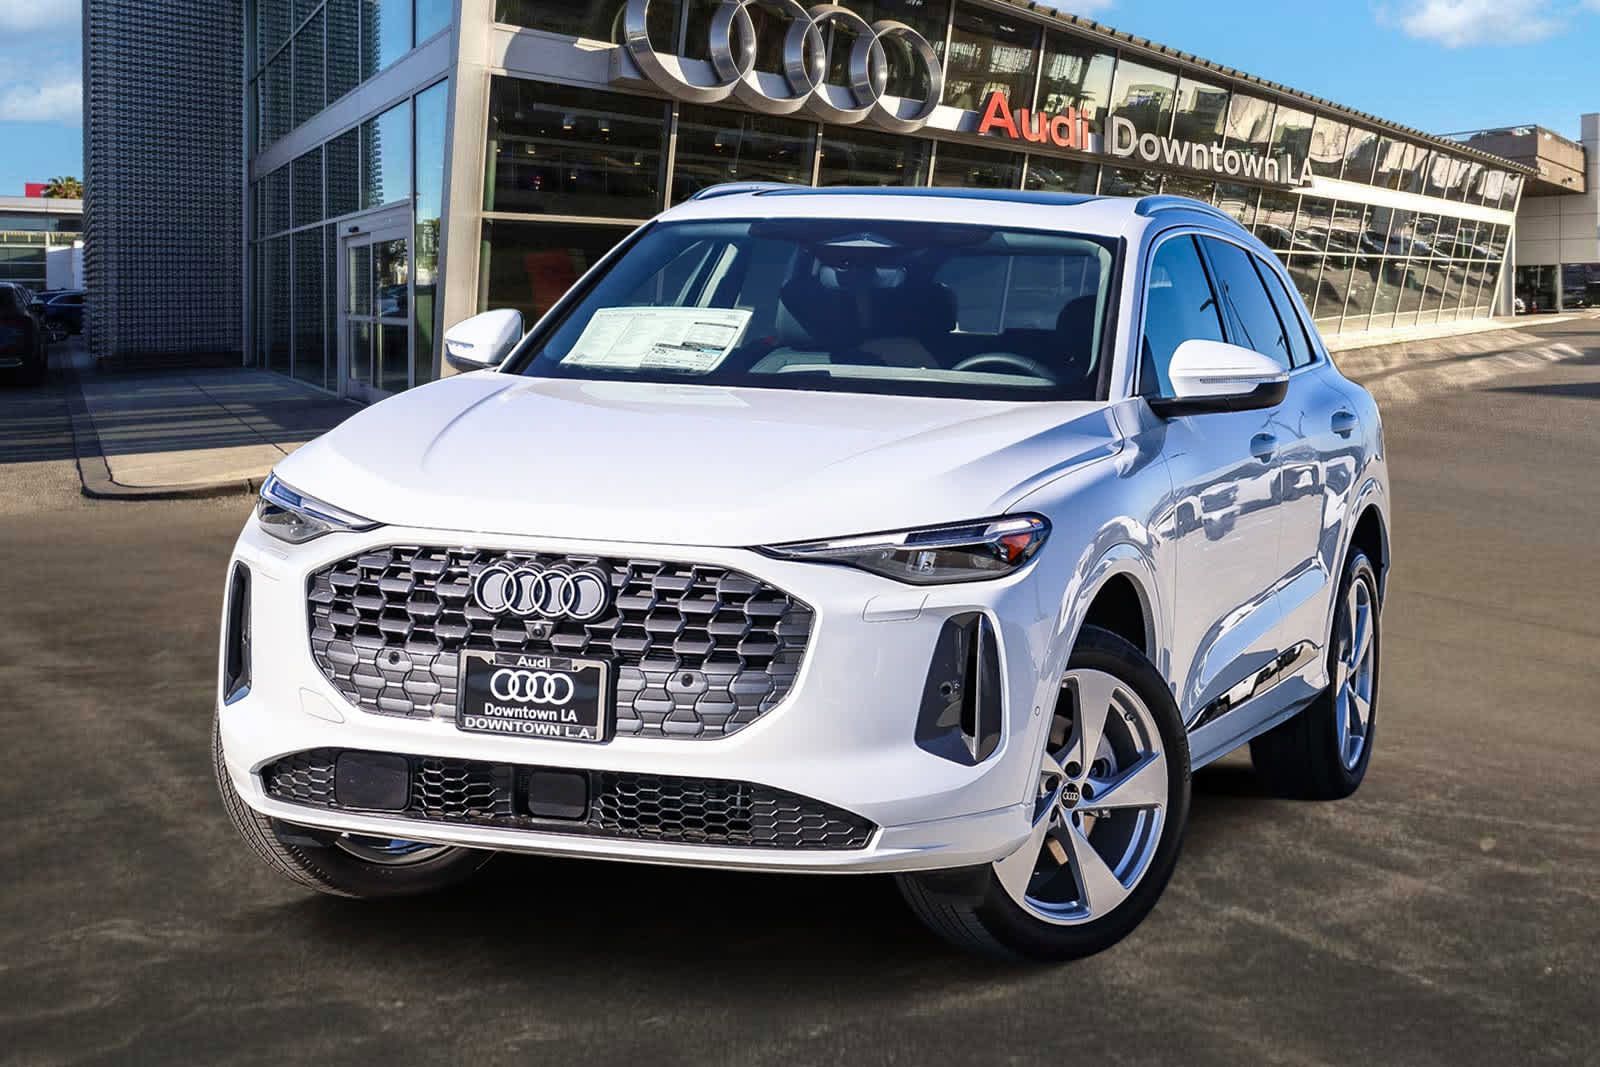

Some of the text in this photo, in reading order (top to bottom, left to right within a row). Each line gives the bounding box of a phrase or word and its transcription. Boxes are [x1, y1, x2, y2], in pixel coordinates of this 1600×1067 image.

[978, 91, 1315, 187] Audi Downtown LA
[517, 656, 551, 669] Audi
[484, 702, 578, 722] Downtown LA
[465, 717, 595, 740] DOWNTOWN L.A.
